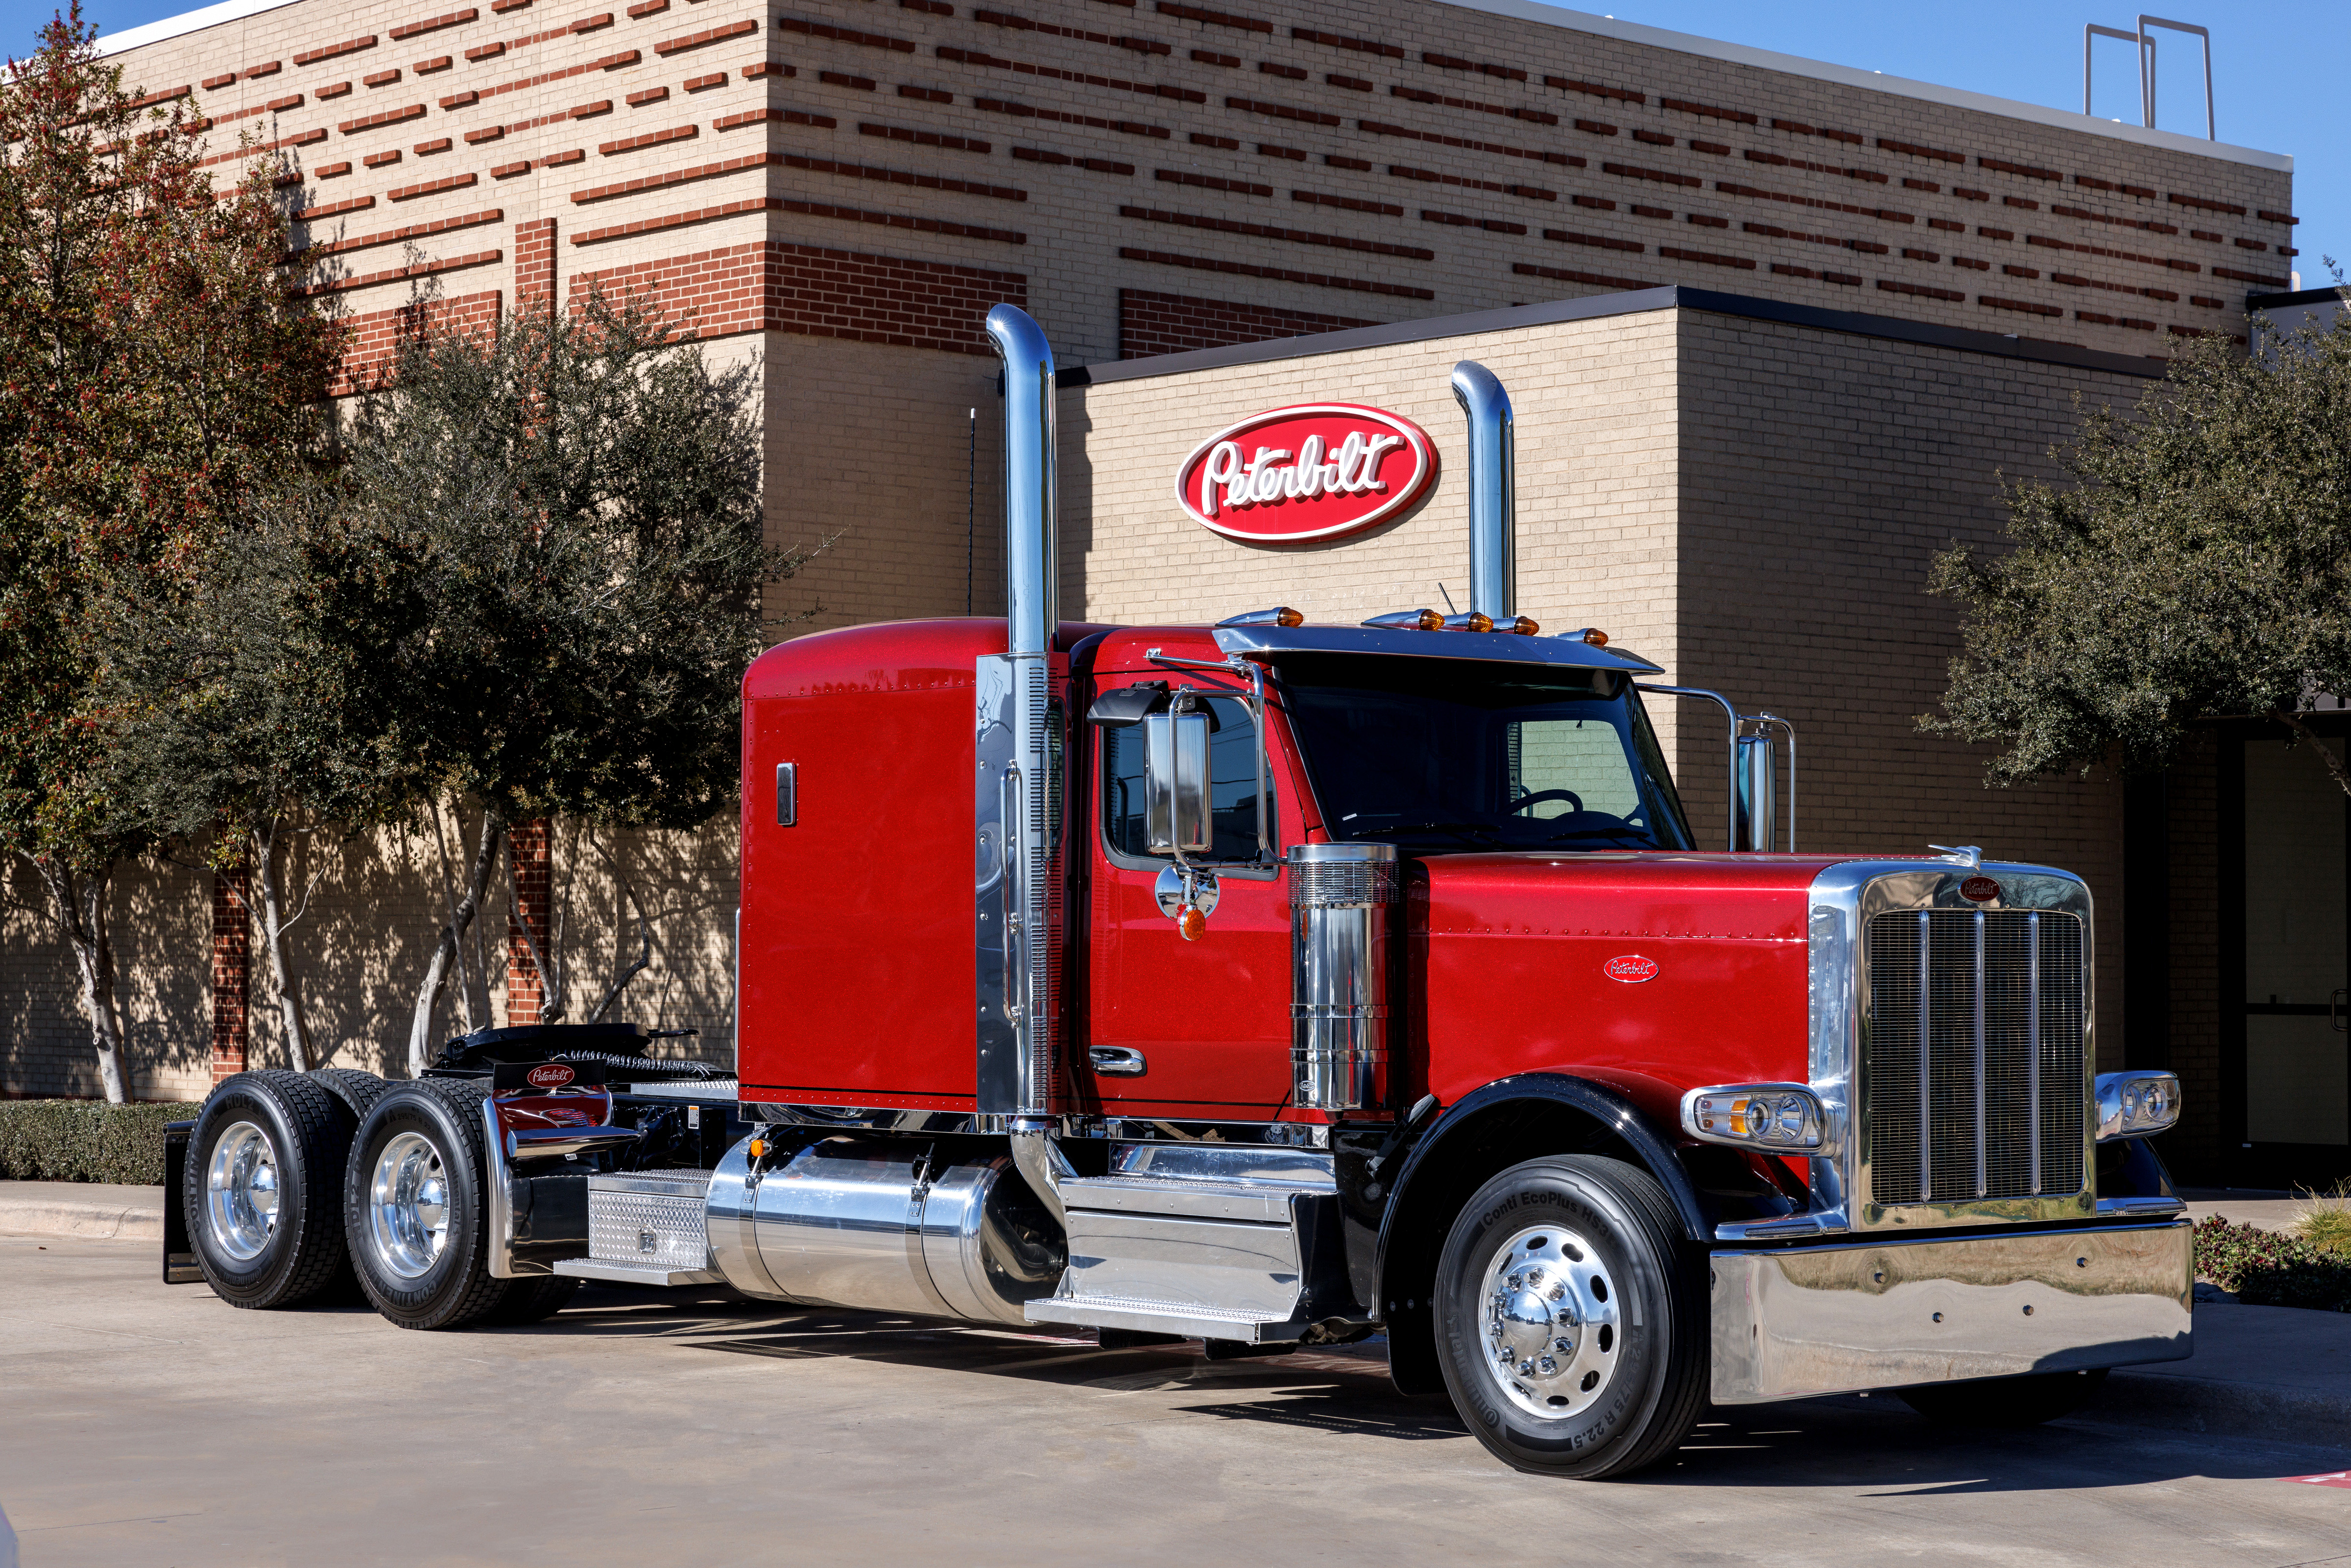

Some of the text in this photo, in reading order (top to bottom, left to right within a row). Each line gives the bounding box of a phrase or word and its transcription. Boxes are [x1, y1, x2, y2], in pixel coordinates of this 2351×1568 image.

[1201, 431, 1405, 515] Peterbilt
[1965, 880, 1997, 895] Peterbilt
[1610, 960, 1654, 975] Peterbilt
[533, 1069, 571, 1083] Peterbilt
[225, 1094, 254, 1111] HDL2
[446, 1150, 461, 1228] Continental
[350, 1185, 362, 1240] HDL2
[1483, 1194, 1517, 1226] Conti
[1521, 1191, 1577, 1212] EcoPlus
[223, 1266, 262, 1287] Continental
[1448, 1332, 1500, 1428] Continental
[1574, 1348, 1641, 1449] 295/75 R 22.5
